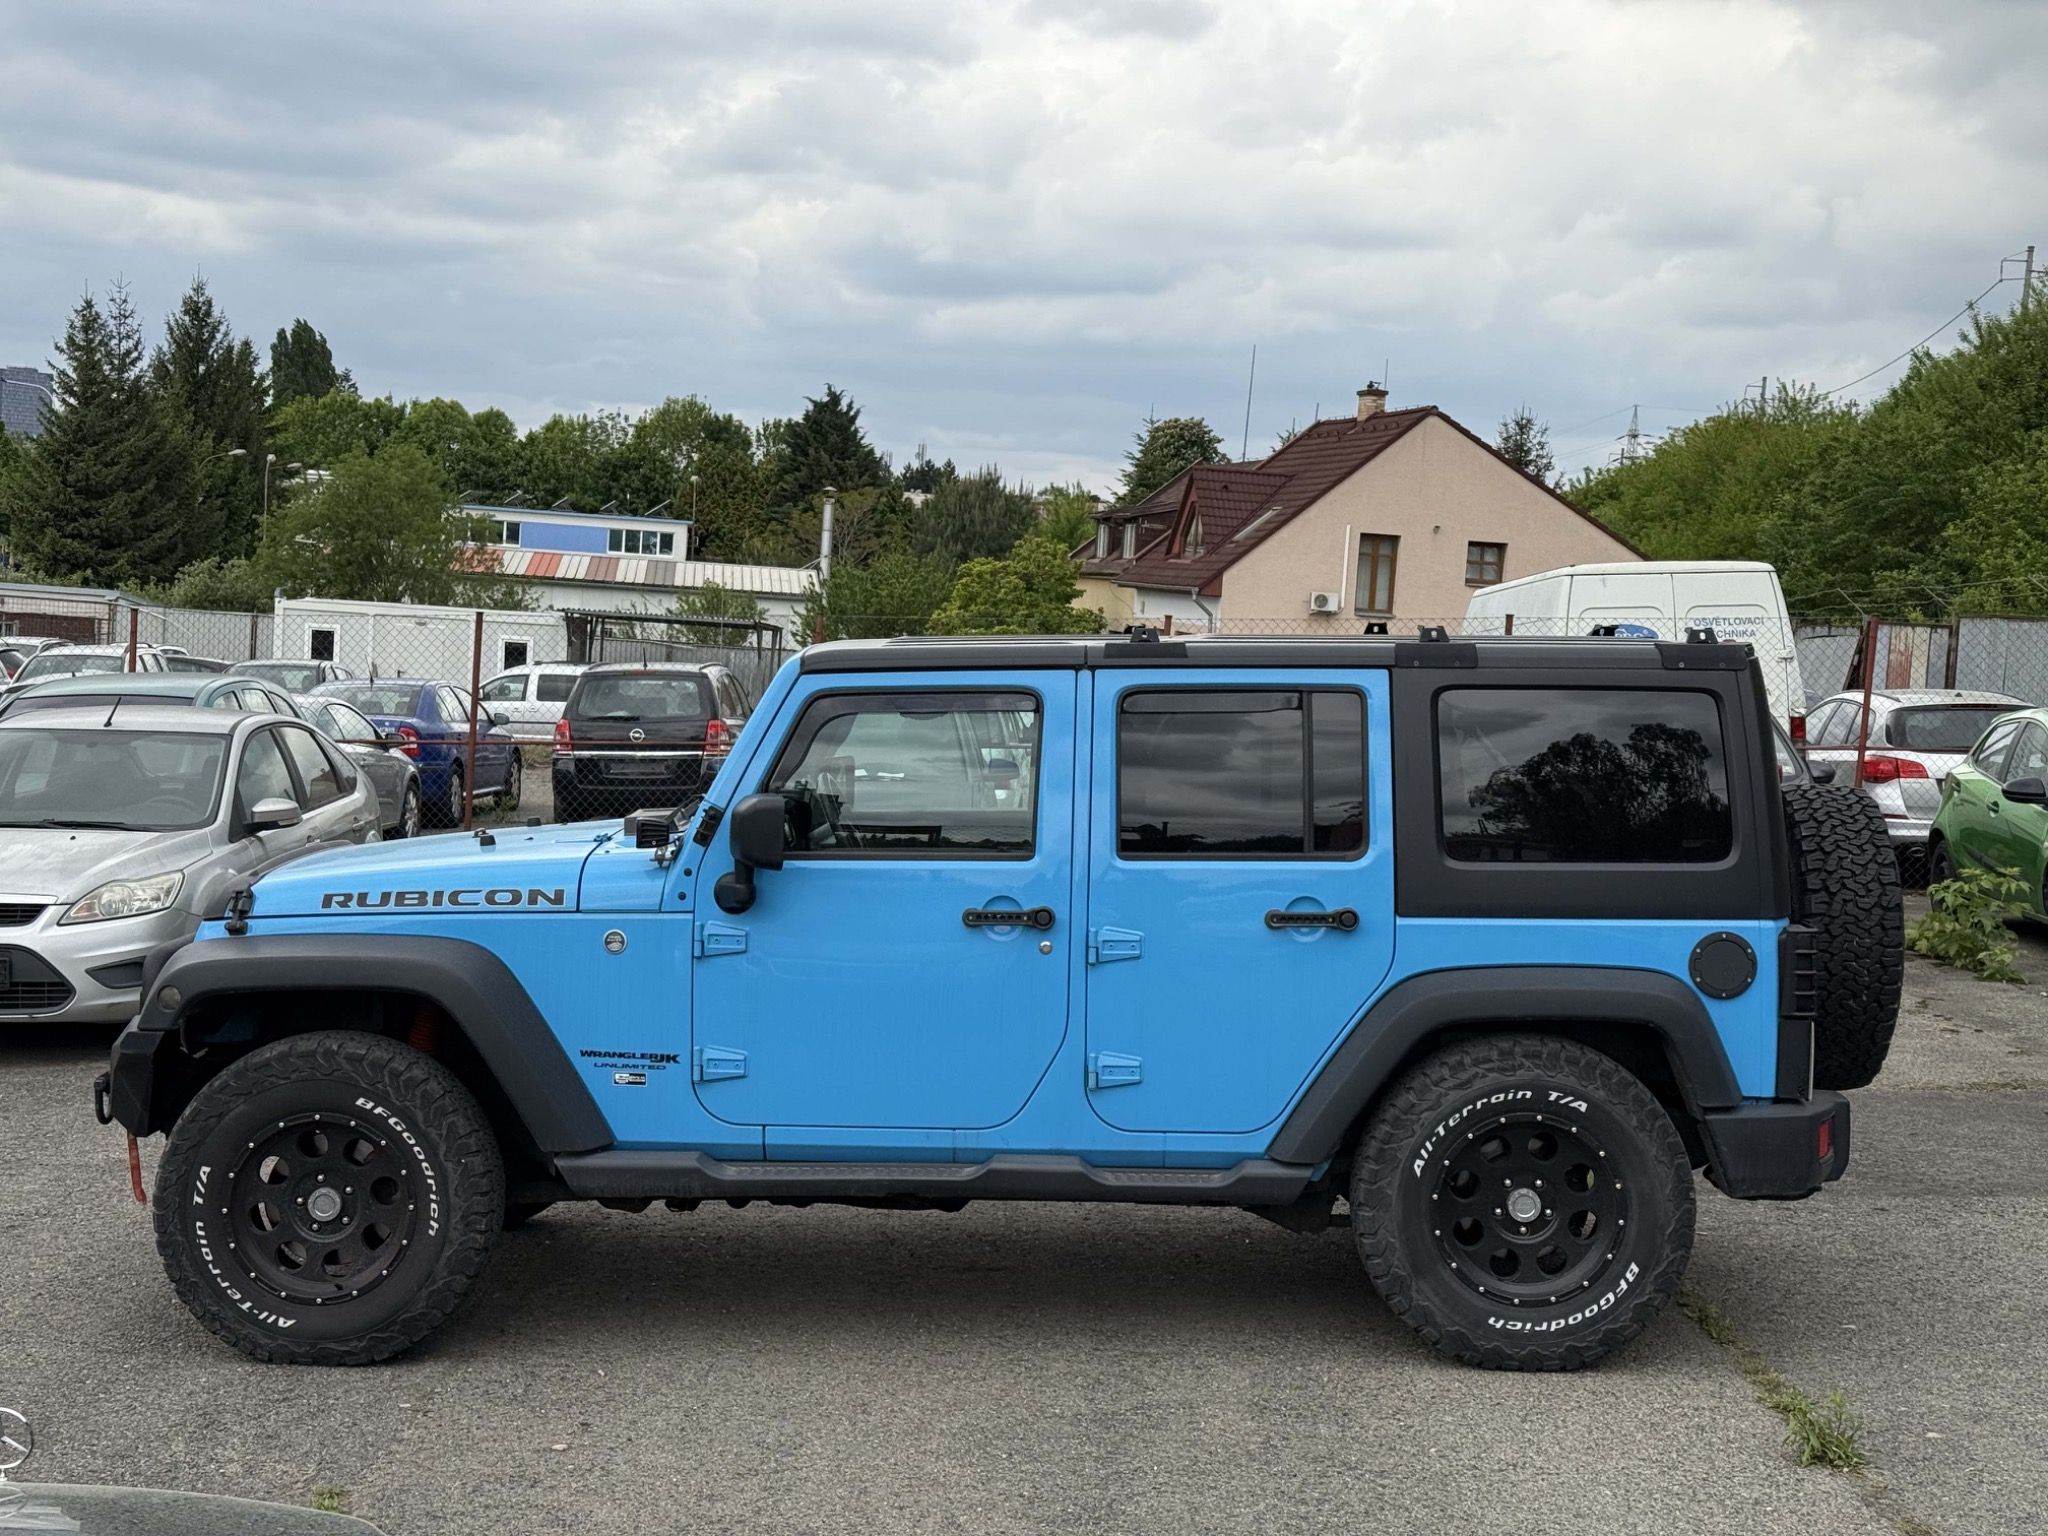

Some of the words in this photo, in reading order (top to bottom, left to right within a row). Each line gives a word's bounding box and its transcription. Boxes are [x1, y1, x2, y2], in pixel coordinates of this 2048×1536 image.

[1715, 628, 1757, 639] CHNIKA
[321, 889, 566, 909] RUBICON
[593, 1062, 667, 1071] UNLIMITED
[1413, 1089, 1533, 1178] All-Terrain
[1548, 1090, 1589, 1113] T/A
[193, 1165, 212, 1206] T/A
[355, 1096, 440, 1237] BFGoodrich
[195, 1221, 297, 1328] All-Terrain
[1487, 1262, 1640, 1333] BFGoodrich
